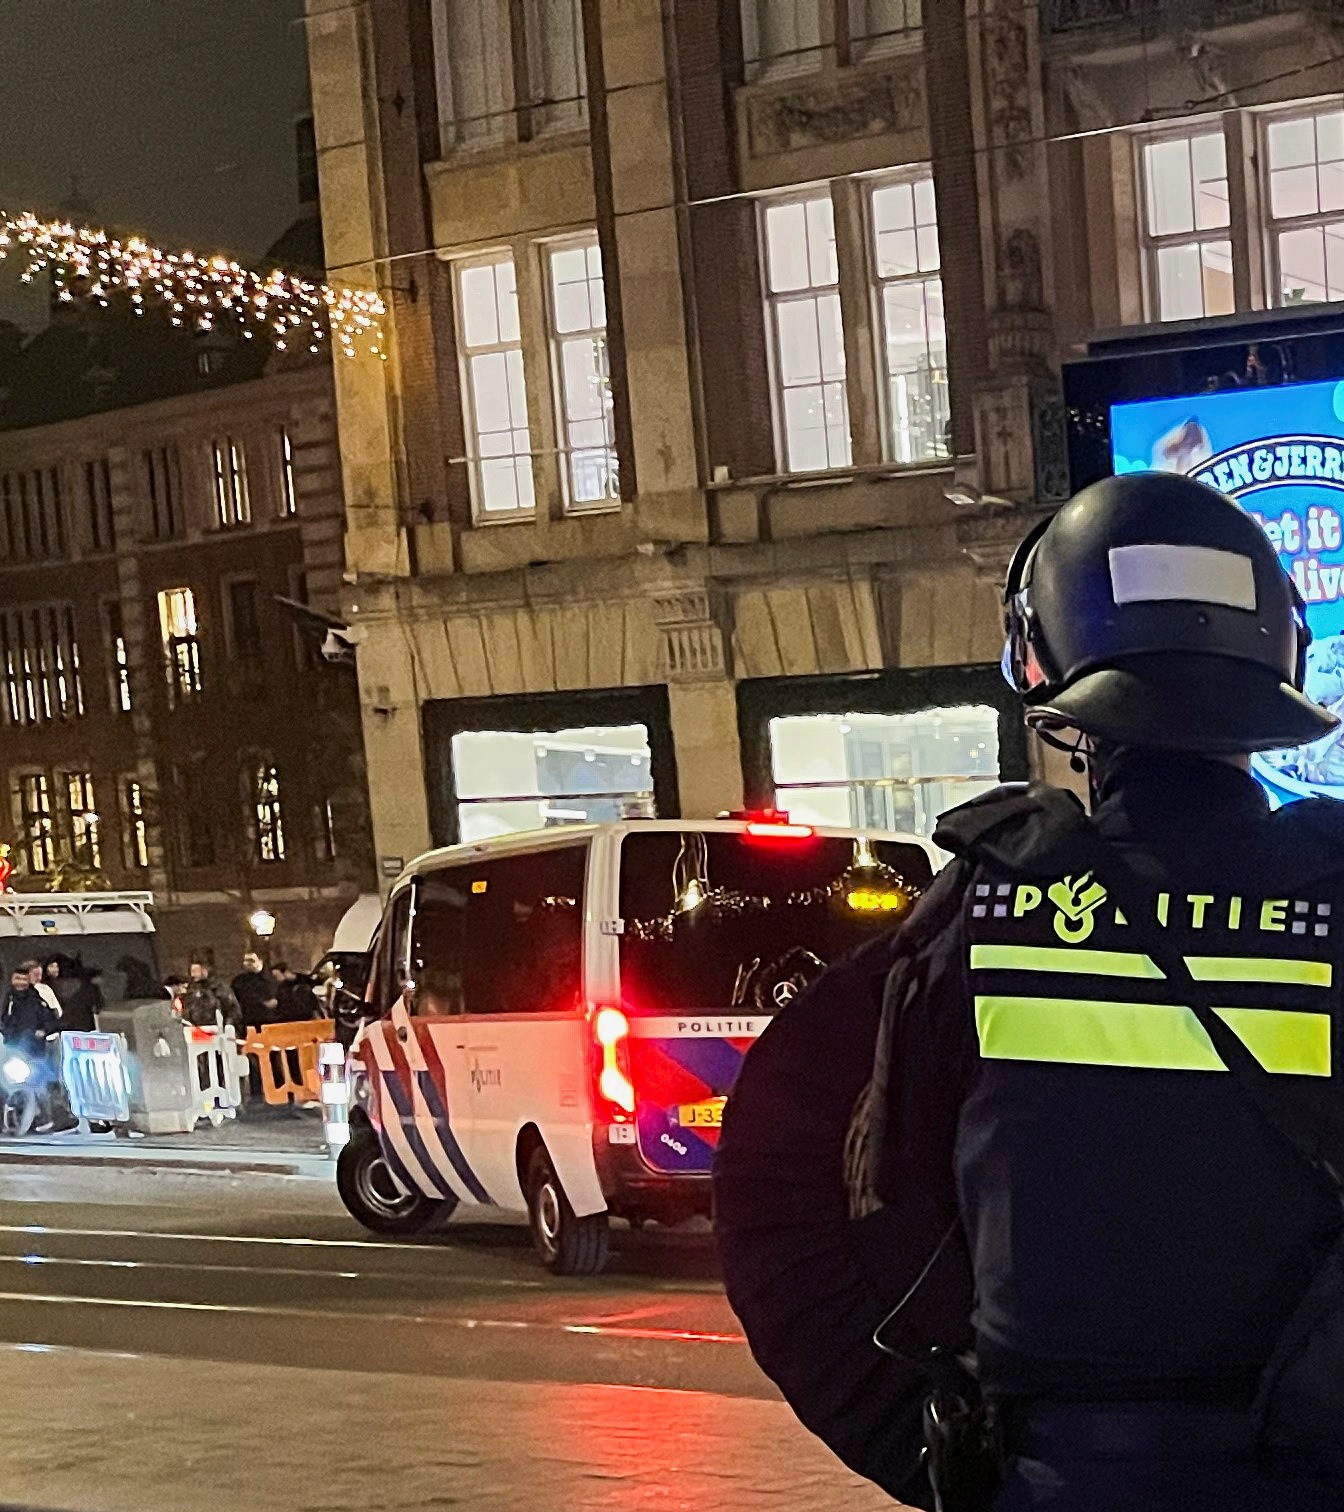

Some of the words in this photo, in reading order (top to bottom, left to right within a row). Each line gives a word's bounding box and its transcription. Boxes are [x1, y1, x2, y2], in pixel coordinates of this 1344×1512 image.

[1254, 512, 1300, 551] et
[1306, 507, 1341, 550] it
[1013, 871, 1290, 943] POITIE
[677, 1021, 755, 1033] POLITIE
